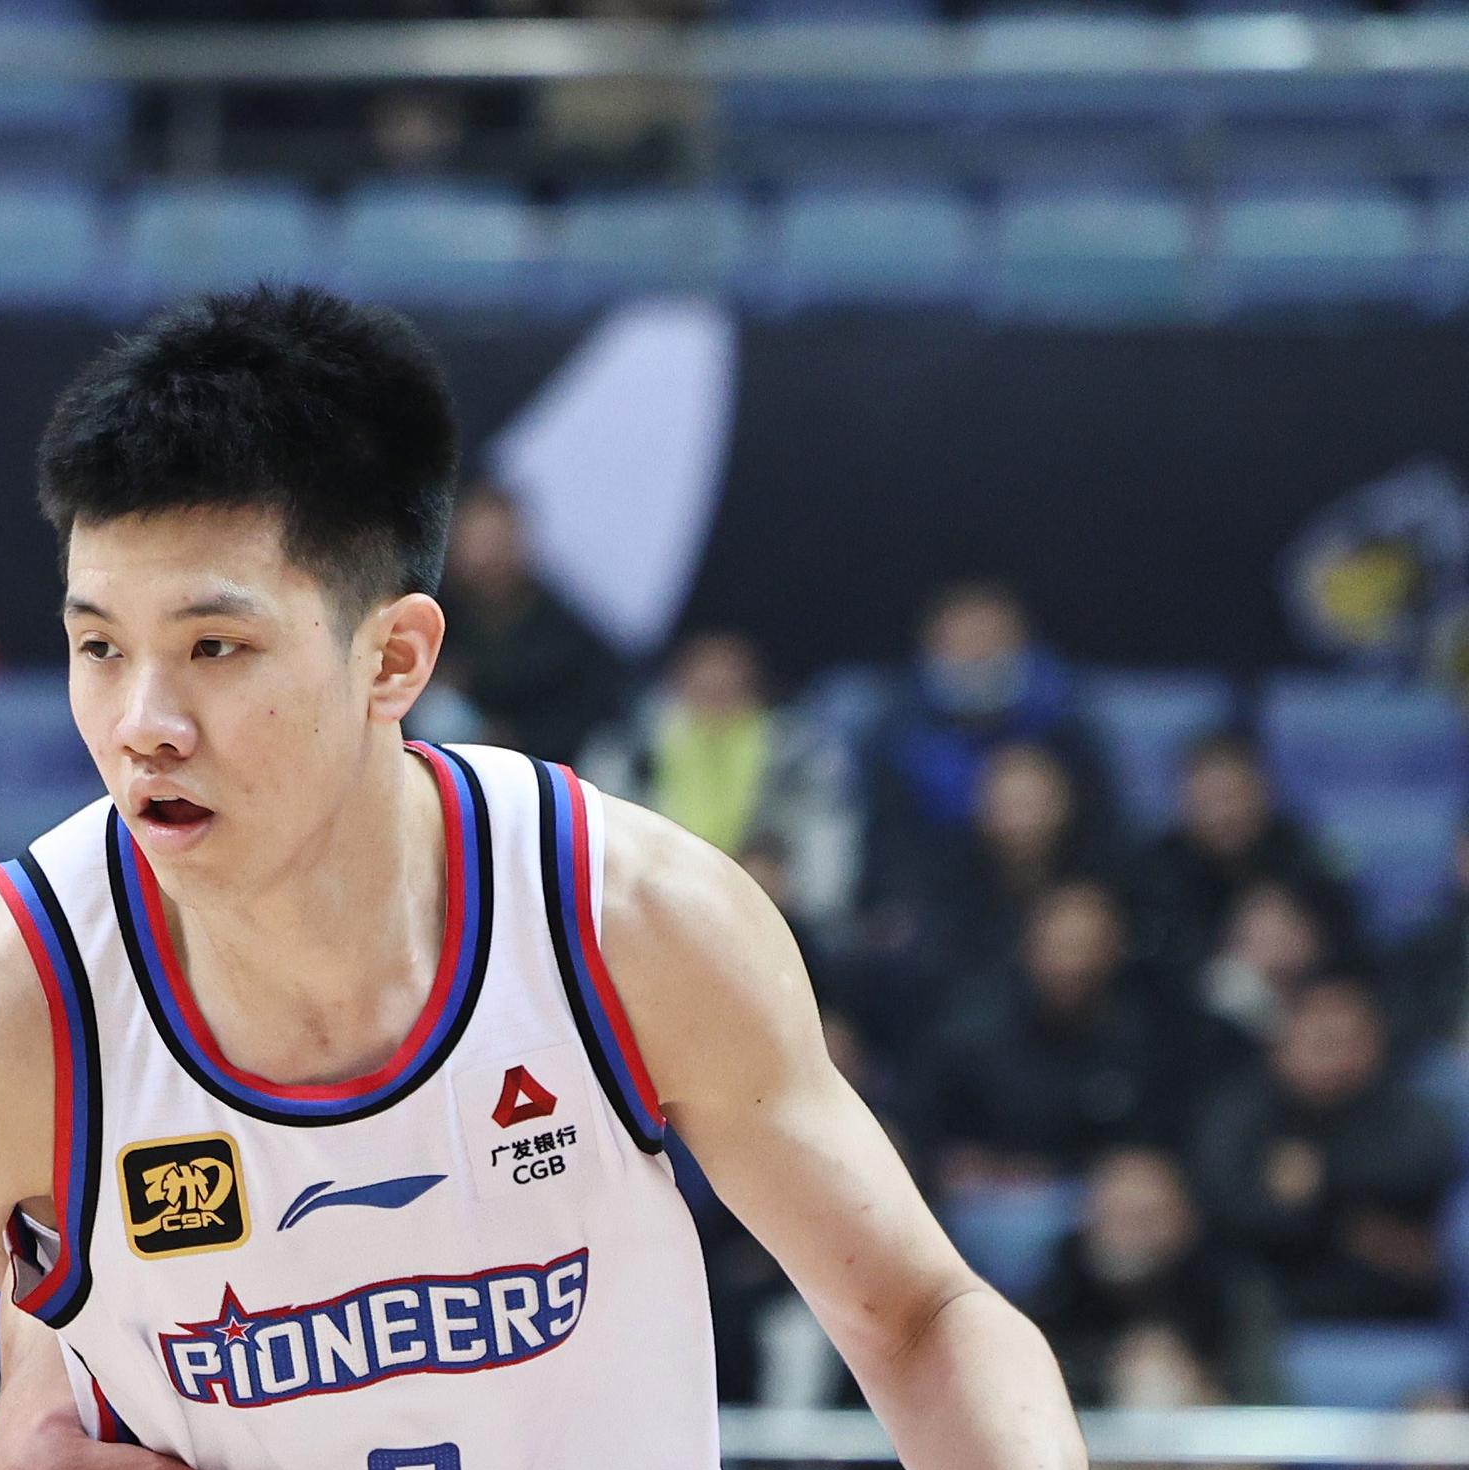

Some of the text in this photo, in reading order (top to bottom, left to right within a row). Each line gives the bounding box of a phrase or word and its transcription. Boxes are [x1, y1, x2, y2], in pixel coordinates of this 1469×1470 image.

[490, 1124, 578, 1168] 广发银行
[512, 1154, 566, 1185] CGB
